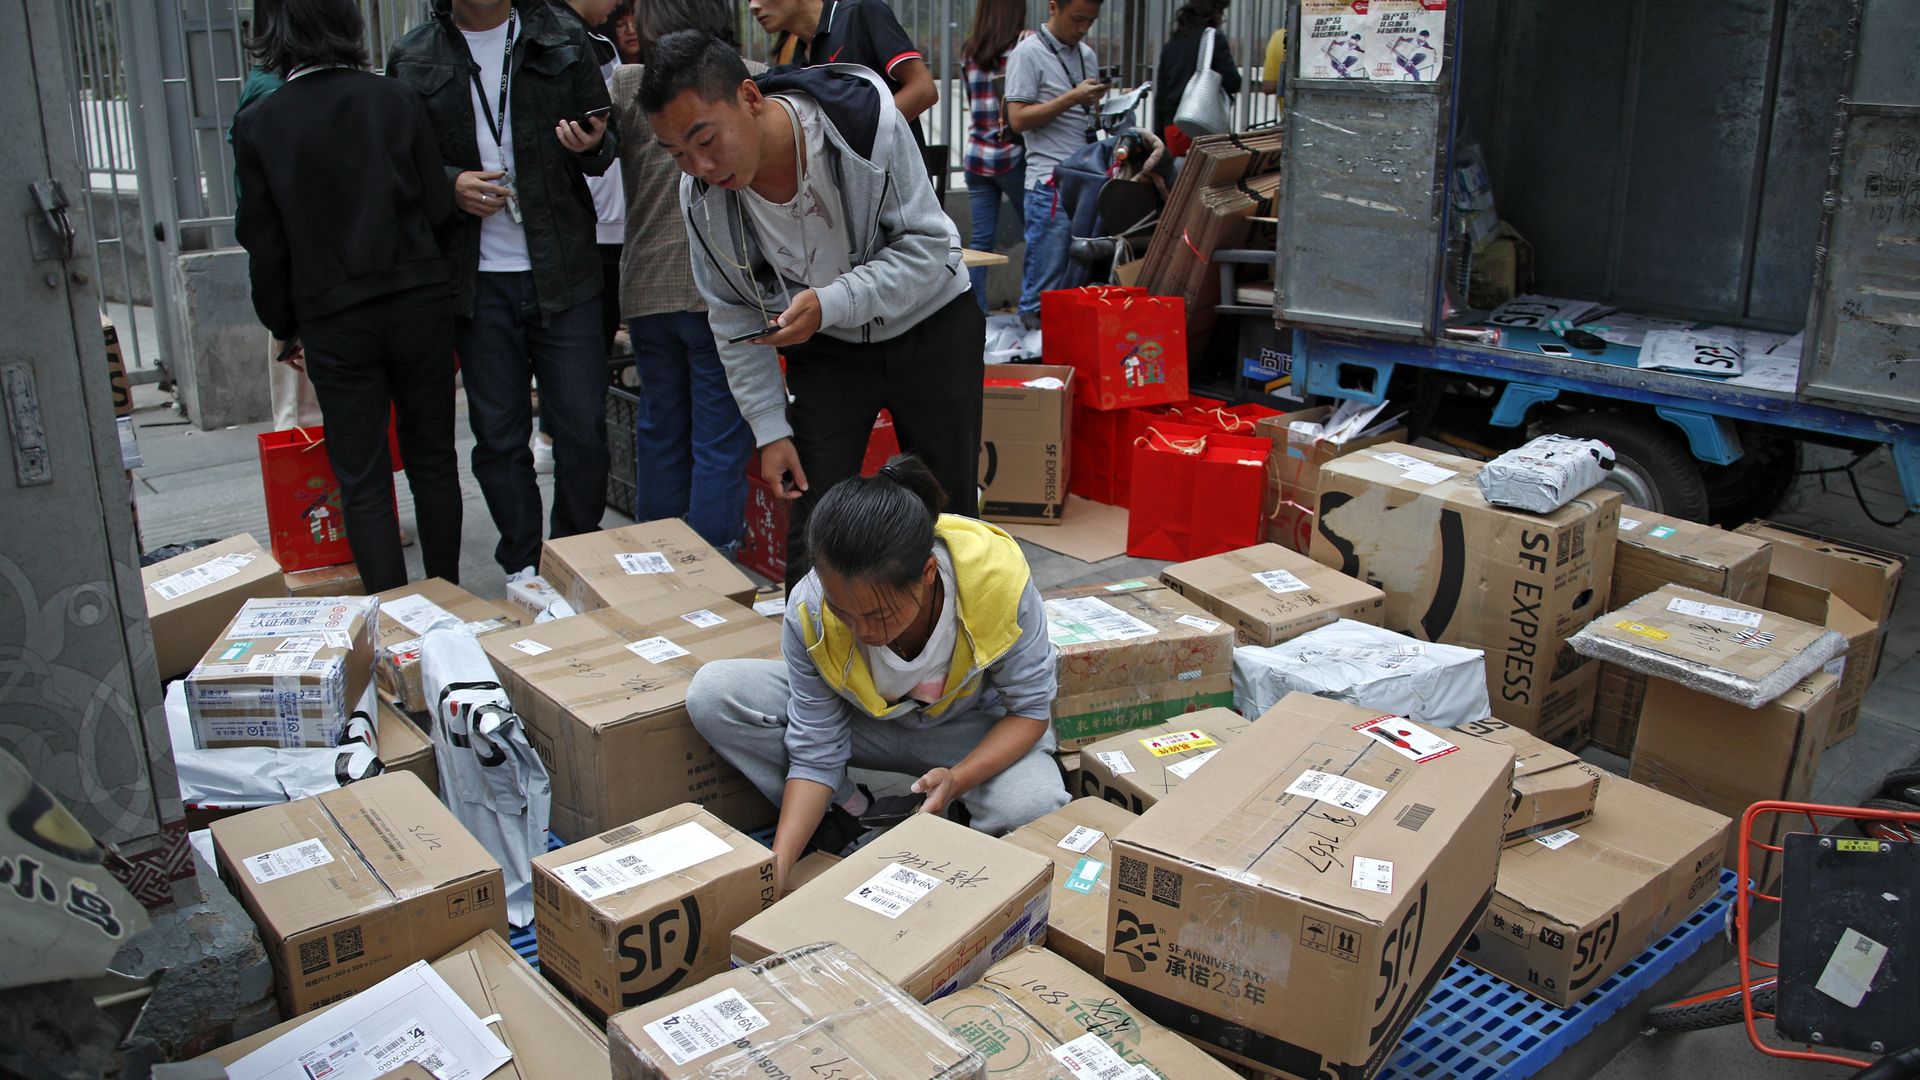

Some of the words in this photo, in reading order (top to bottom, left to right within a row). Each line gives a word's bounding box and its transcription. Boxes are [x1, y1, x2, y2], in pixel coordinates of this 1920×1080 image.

[1045, 443, 1057, 457] SF
[1044, 459, 1057, 502] EXPRESS
[1042, 504, 1056, 517] 4
[1519, 529, 1551, 575] SF
[1501, 580, 1543, 706] EXPRESS
[759, 862, 774, 883] SF
[1493, 913, 1525, 940] 快递
[1543, 928, 1564, 949] Y5
[618, 908, 681, 983] SF
[1374, 901, 1418, 1013] SF
[1572, 919, 1612, 973] SF
[1165, 954, 1267, 1006] 承诺25年
[1184, 946, 1268, 985] ANNIVERSARY
[682, 1013, 721, 1049] 010W-010CC
[735, 1012, 758, 1032] N9A
[377, 1037, 427, 1072] 010W-010CC
